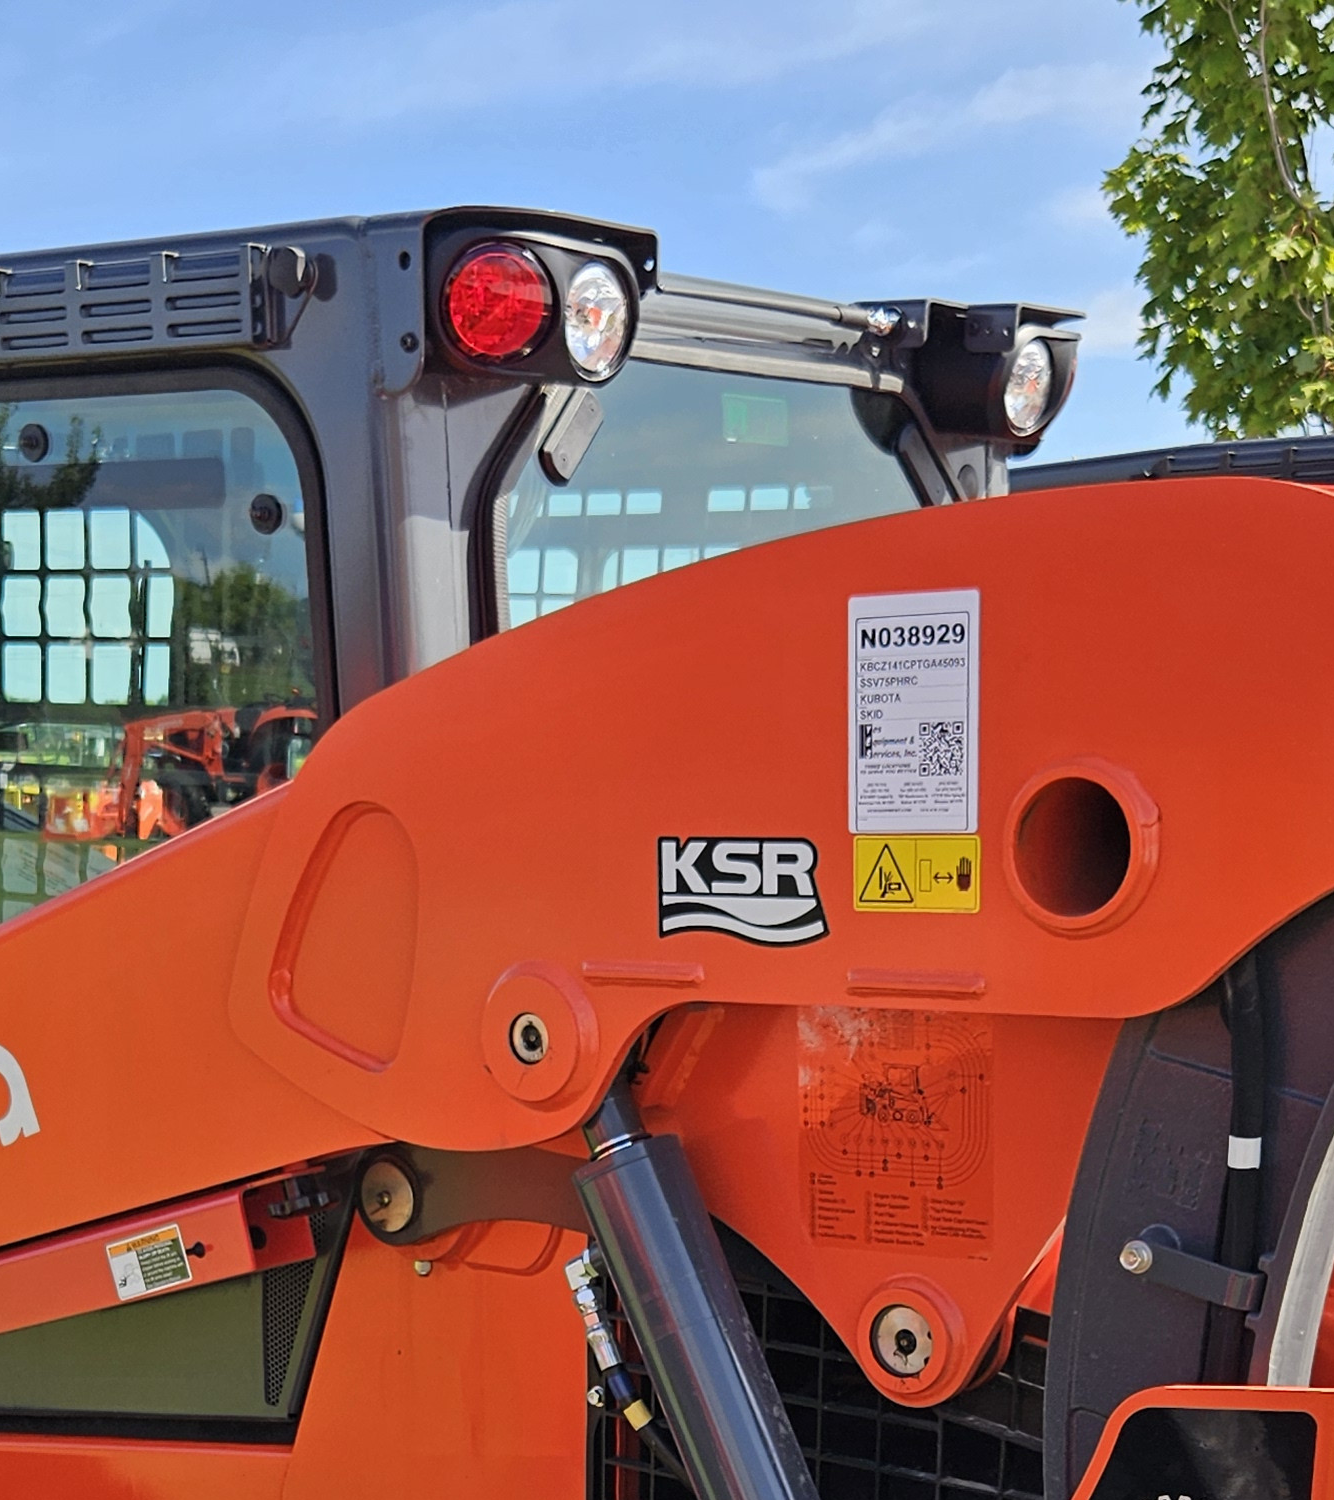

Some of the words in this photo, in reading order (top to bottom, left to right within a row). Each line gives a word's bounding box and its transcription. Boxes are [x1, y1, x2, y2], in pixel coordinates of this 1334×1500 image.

[860, 623, 966, 649] N038929
[859, 675, 919, 689] SSV75PHRC
[860, 693, 902, 705] KUBOTA
[859, 709, 884, 721] SKID
[661, 839, 815, 896] KSR
